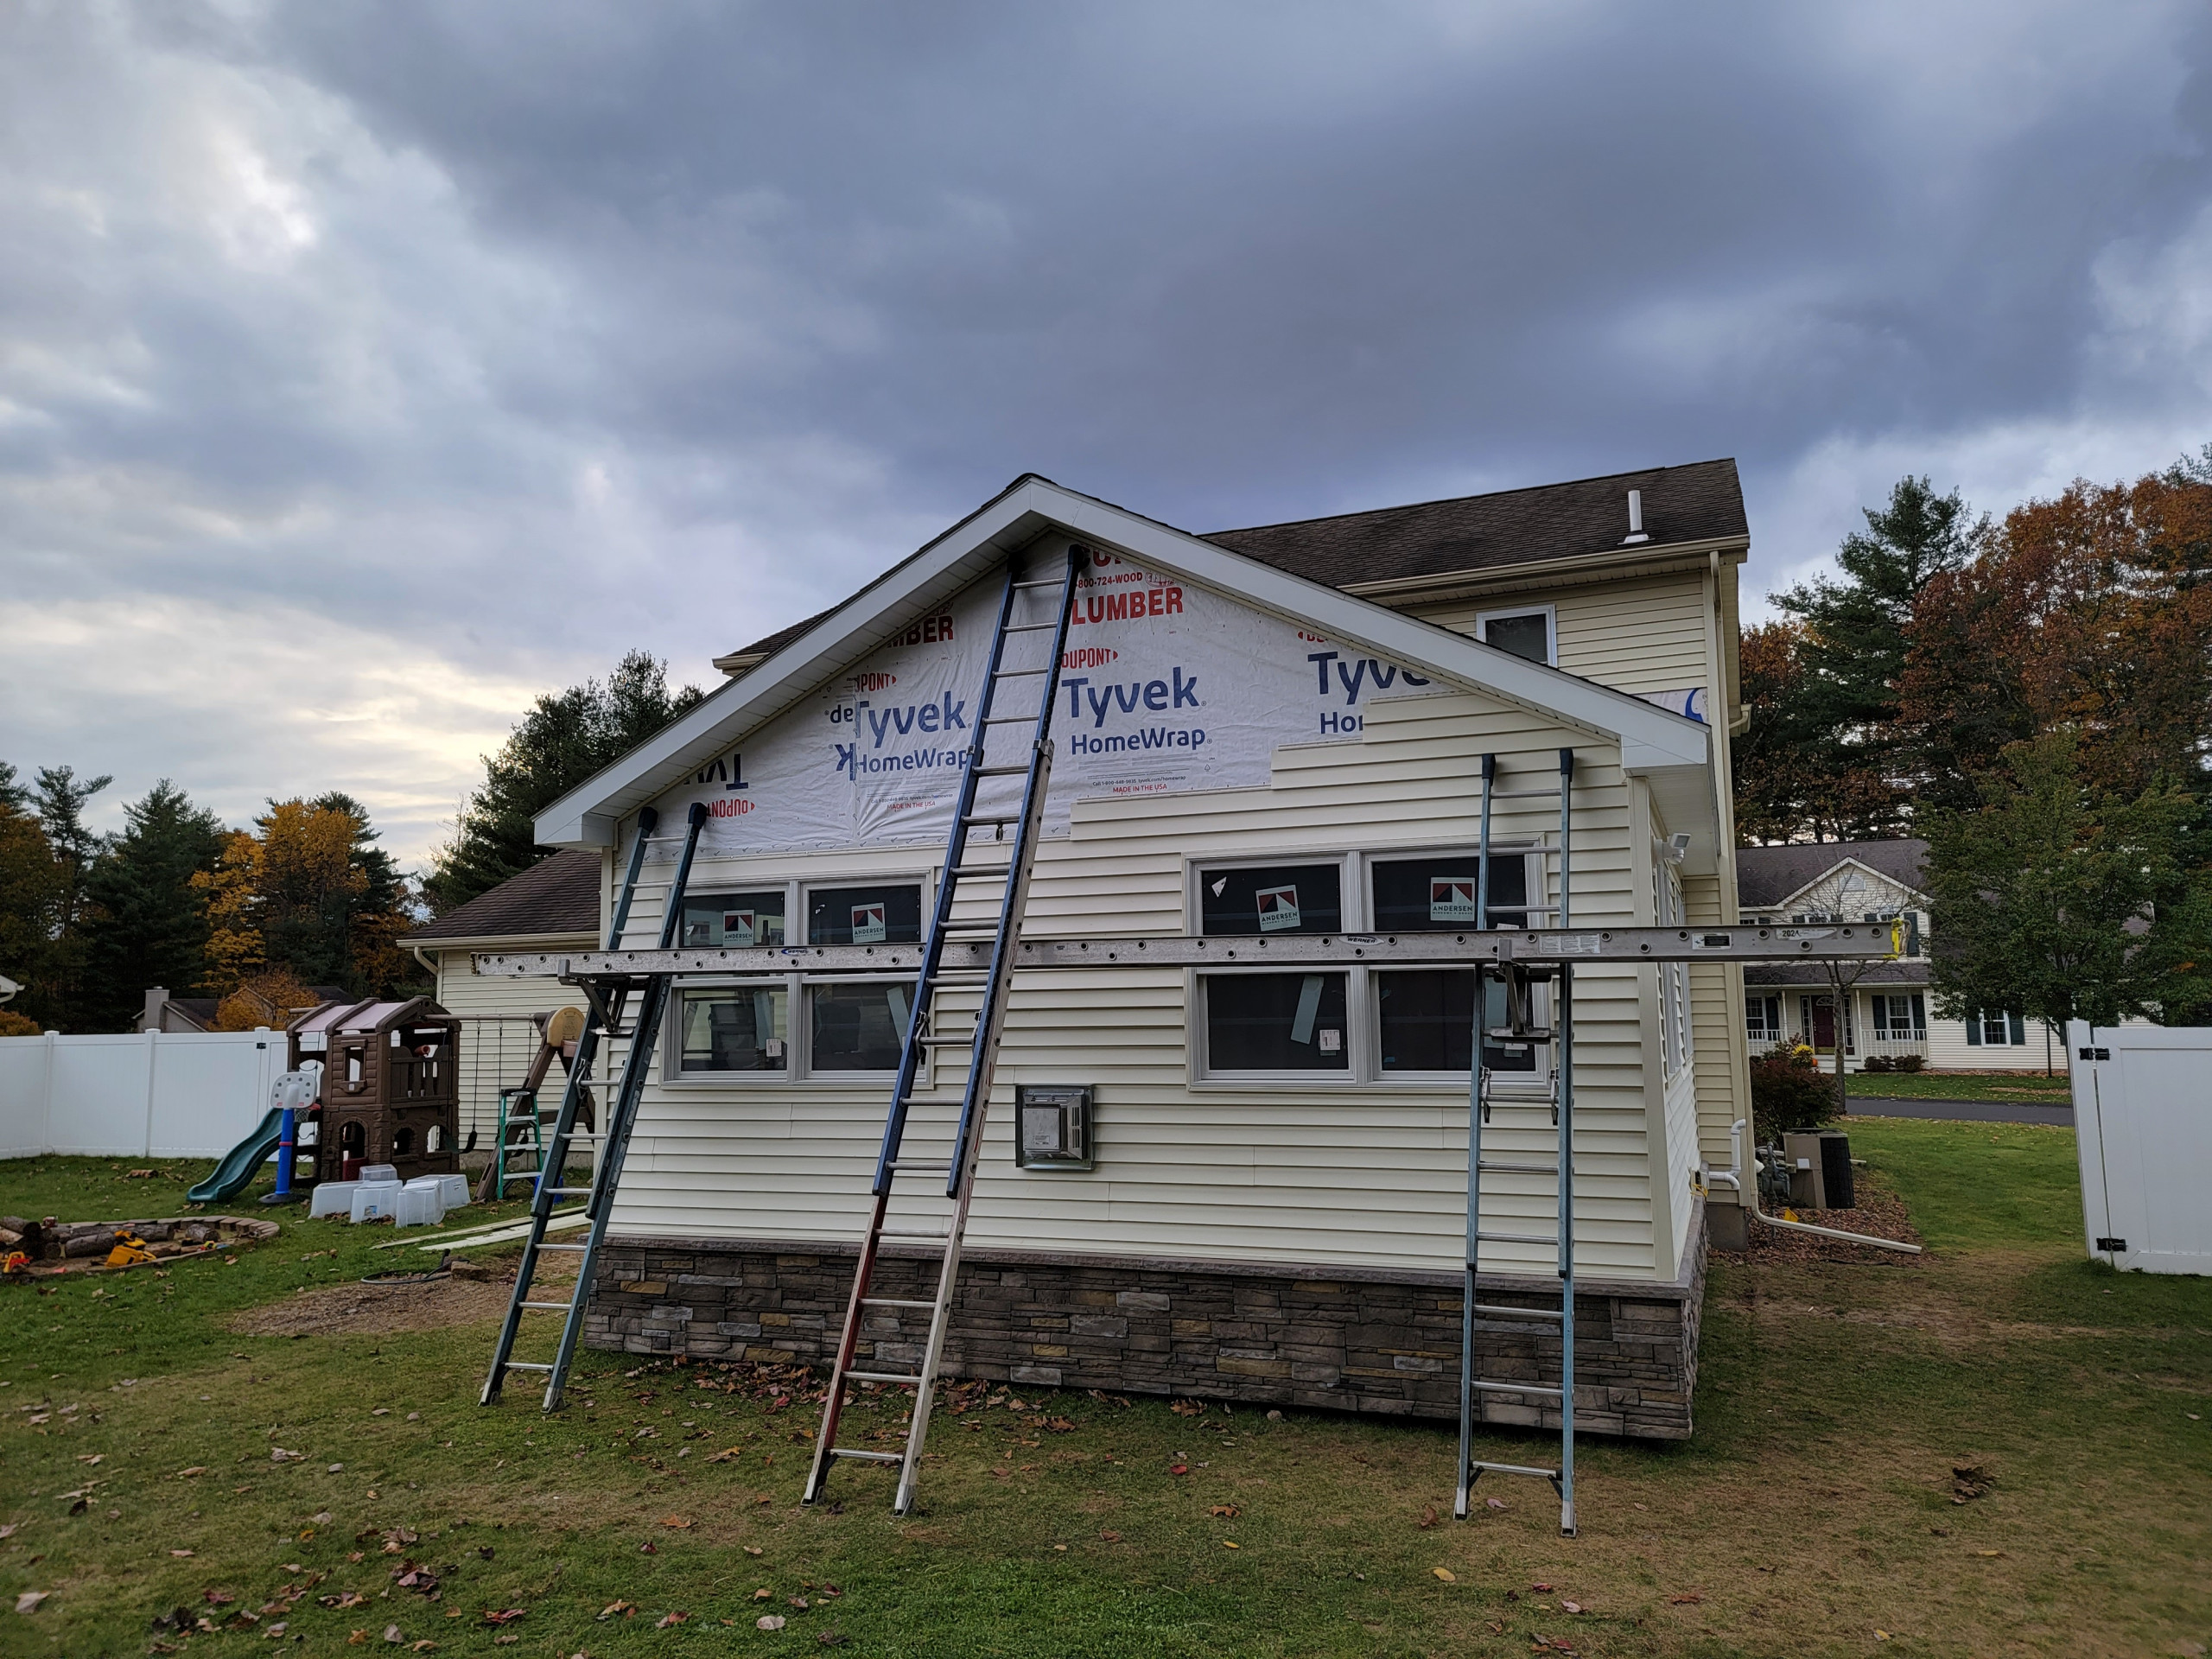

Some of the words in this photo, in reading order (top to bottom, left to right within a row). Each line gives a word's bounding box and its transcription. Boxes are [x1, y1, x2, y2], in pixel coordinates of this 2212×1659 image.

[1071, 587, 1184, 626] LUMBER
[1061, 647, 1111, 669] DUPONT
[1061, 666, 1200, 728] Tyvek
[855, 690, 967, 749] Tyvek
[1071, 727, 1205, 755] HomeWrap
[855, 747, 968, 774] HomeWrap
[1262, 912, 1298, 922] ANDERSEN
[854, 926, 884, 936] ANDERSEN
